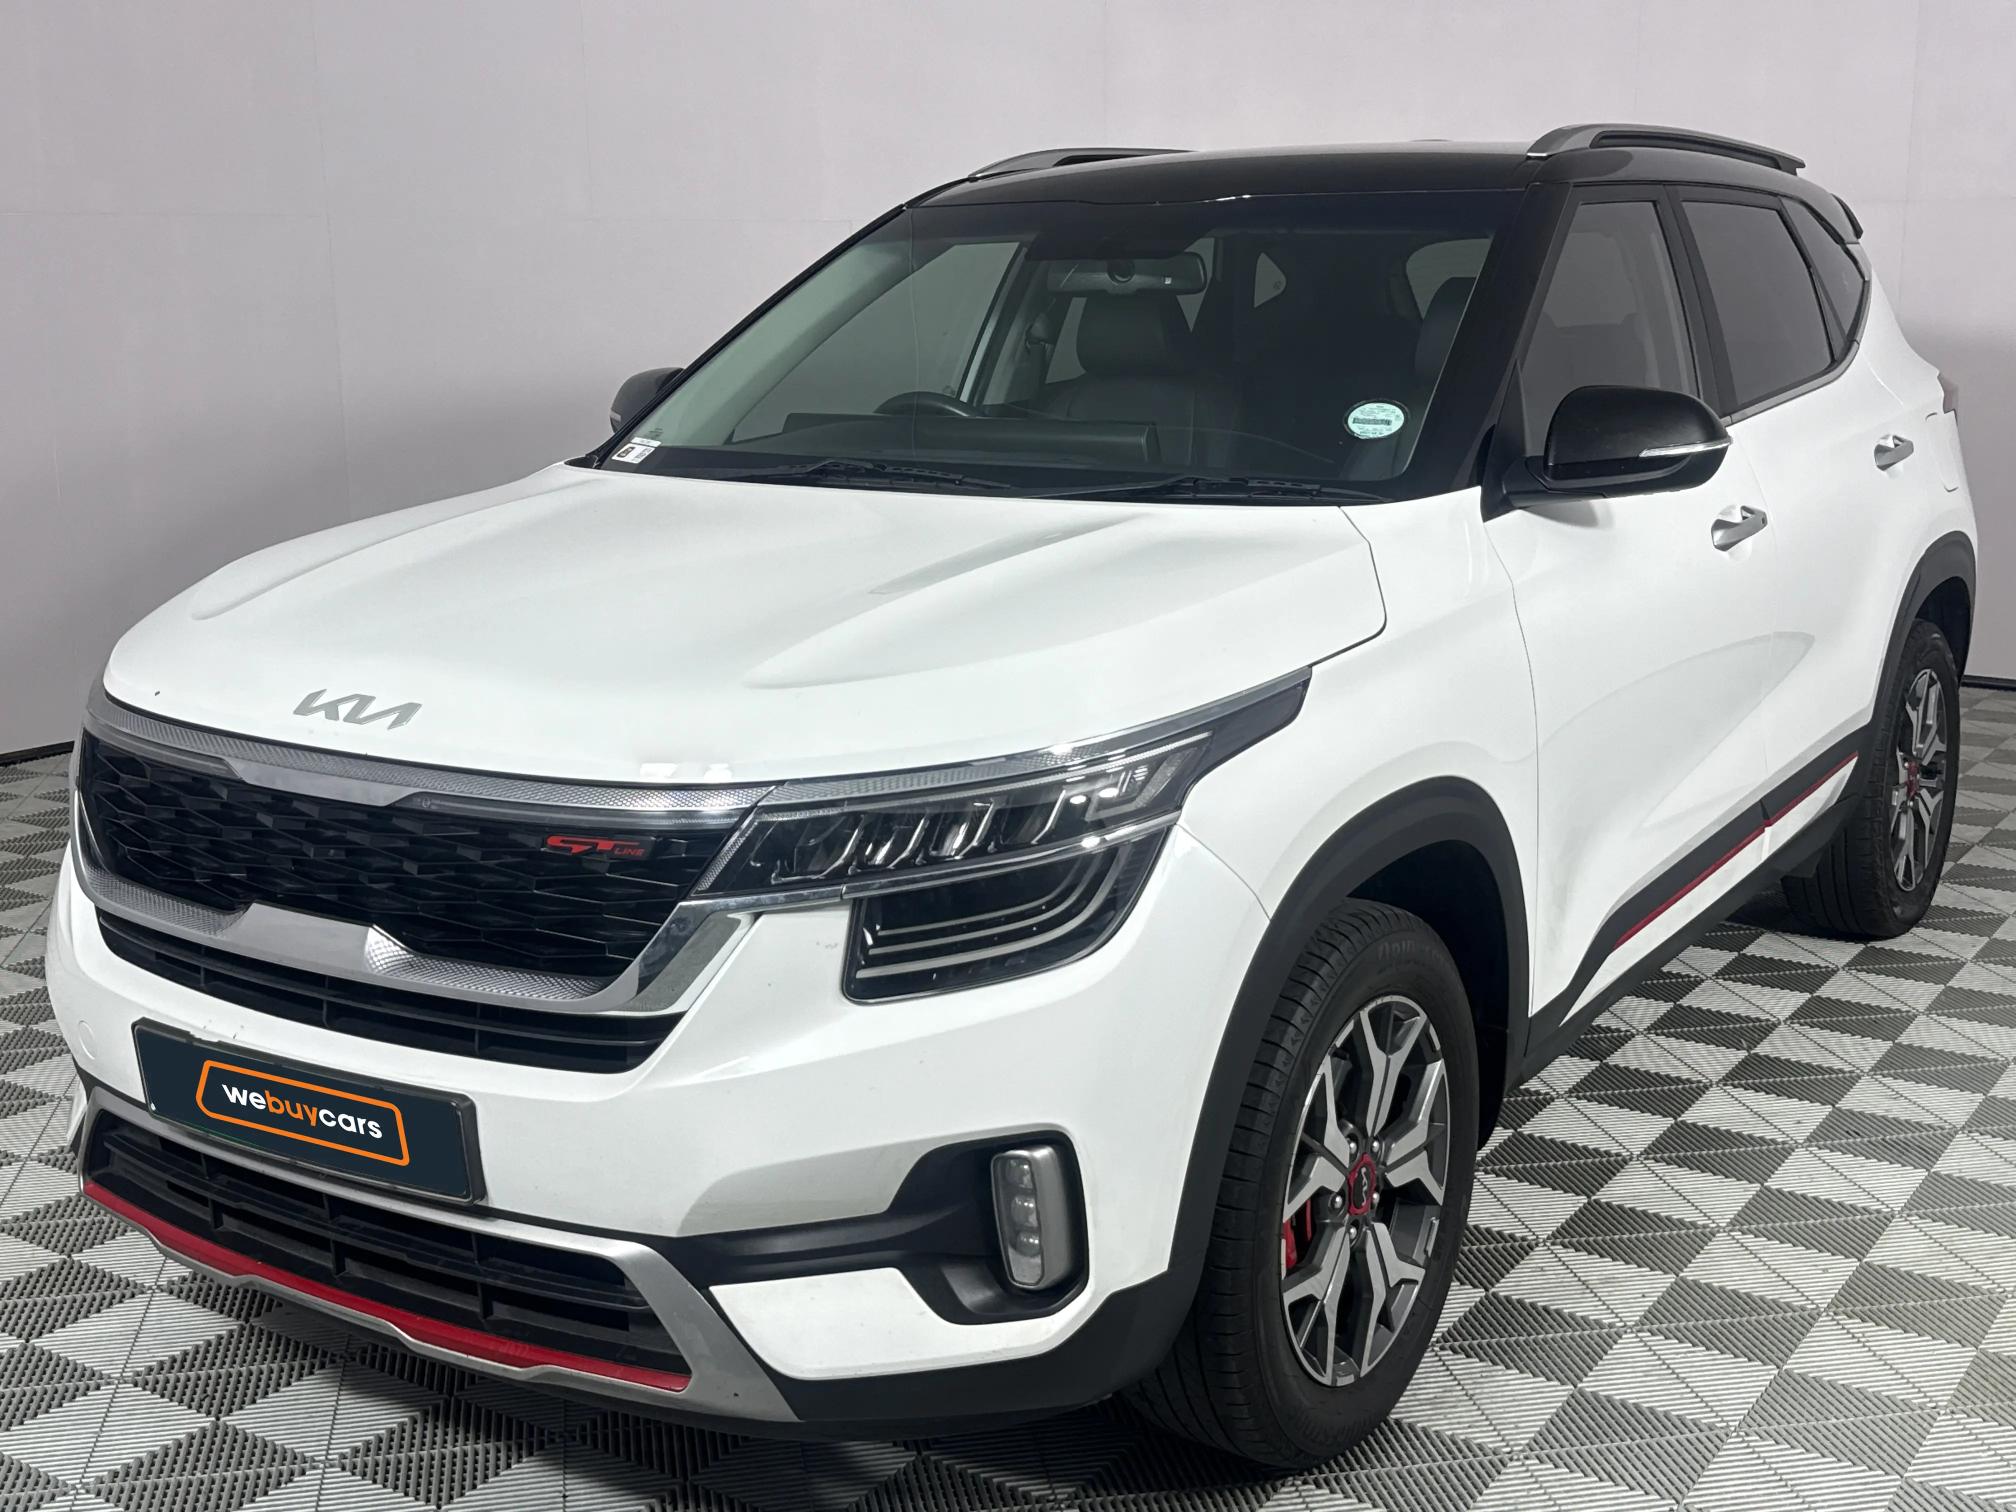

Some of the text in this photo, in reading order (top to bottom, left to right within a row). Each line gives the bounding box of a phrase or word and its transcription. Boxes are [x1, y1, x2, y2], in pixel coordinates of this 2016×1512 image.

[293, 688, 423, 731] KIA
[546, 835, 646, 857] GT LINE
